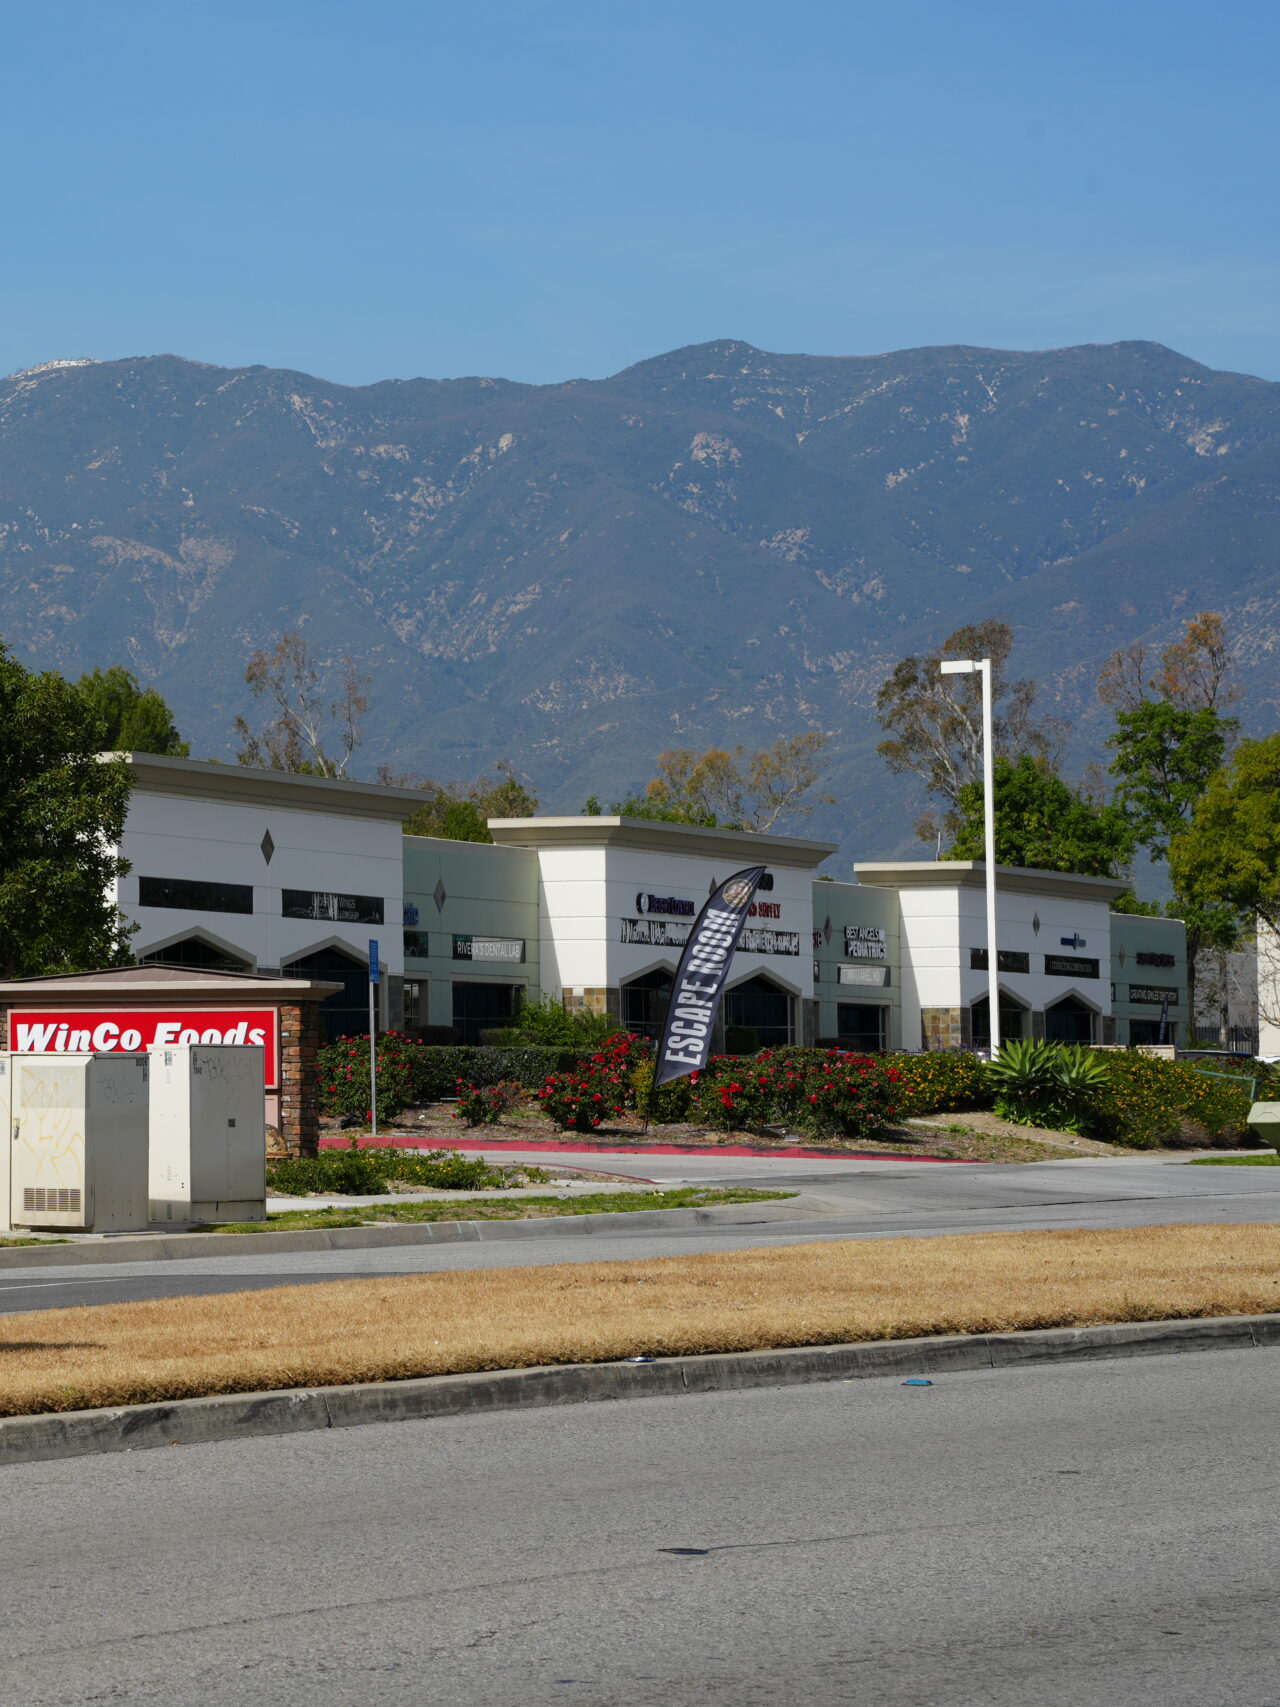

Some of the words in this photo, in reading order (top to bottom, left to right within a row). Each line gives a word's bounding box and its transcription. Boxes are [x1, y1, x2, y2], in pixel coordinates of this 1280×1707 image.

[686, 908, 741, 976] ROOM
[846, 926, 858, 939] BEST
[859, 927, 879, 941] ANGELS
[457, 942, 484, 956] RIVERA'S
[485, 944, 508, 957] DENTAL
[508, 945, 520, 958] LAB
[848, 941, 888, 958] PEDIATRICS
[664, 978, 719, 1065] ESCAPE
[16, 1022, 141, 1051] WinCo
[153, 1021, 266, 1045] Foods
